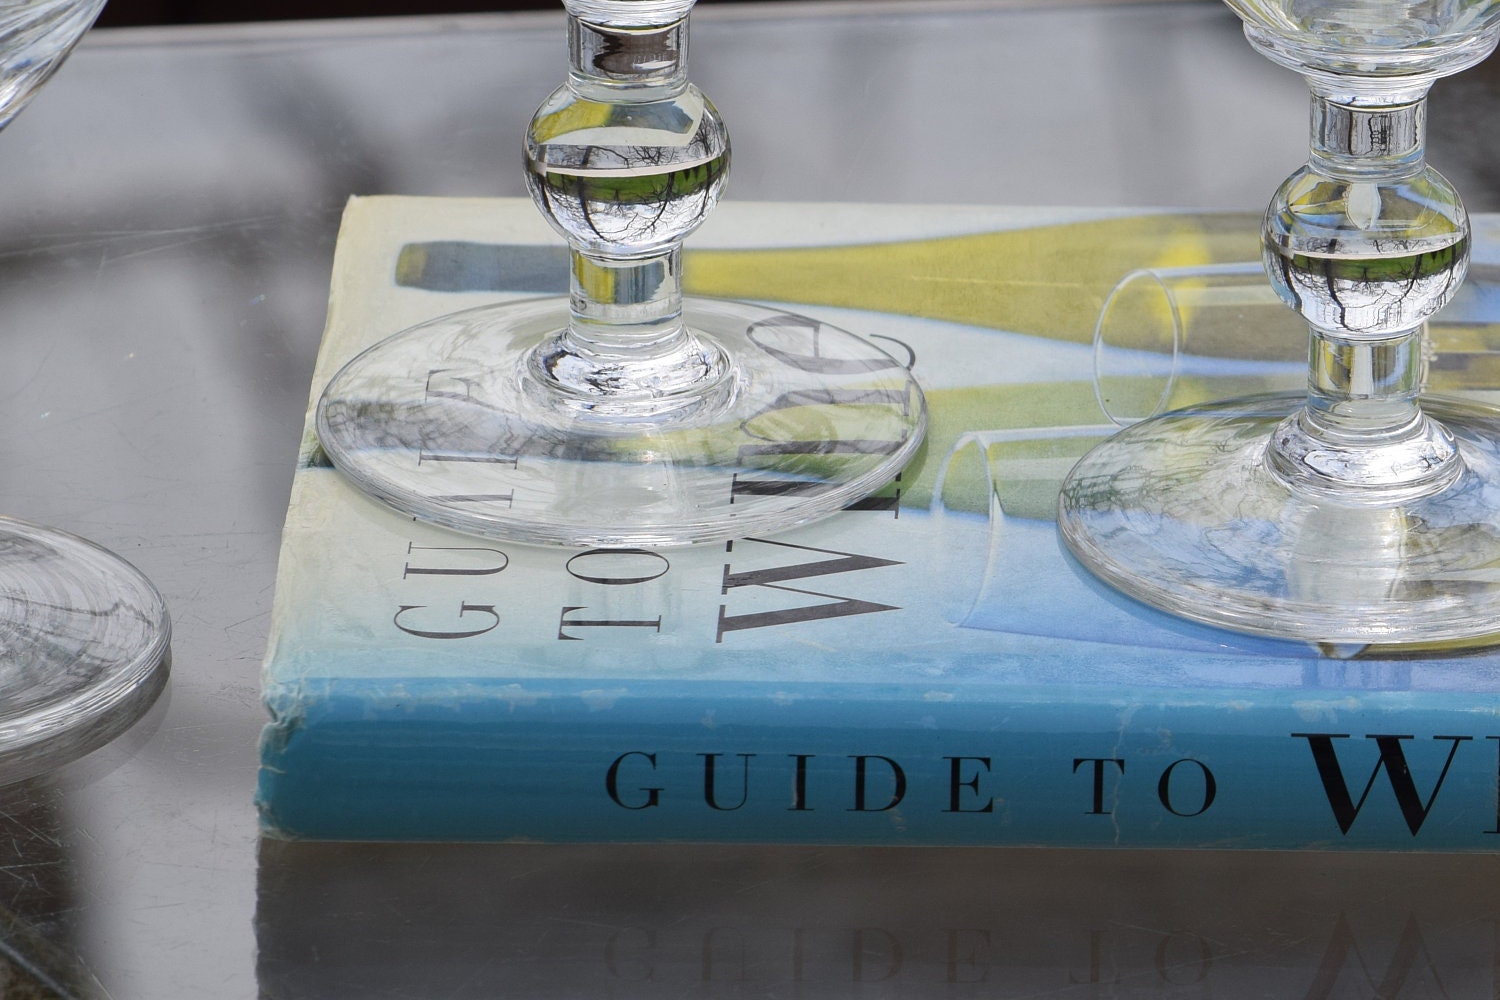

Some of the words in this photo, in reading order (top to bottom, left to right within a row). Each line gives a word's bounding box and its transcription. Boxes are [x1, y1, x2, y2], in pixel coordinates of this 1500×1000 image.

[558, 547, 670, 640] TO
[605, 750, 994, 813] GUIDE
[1072, 757, 1218, 818] TO
